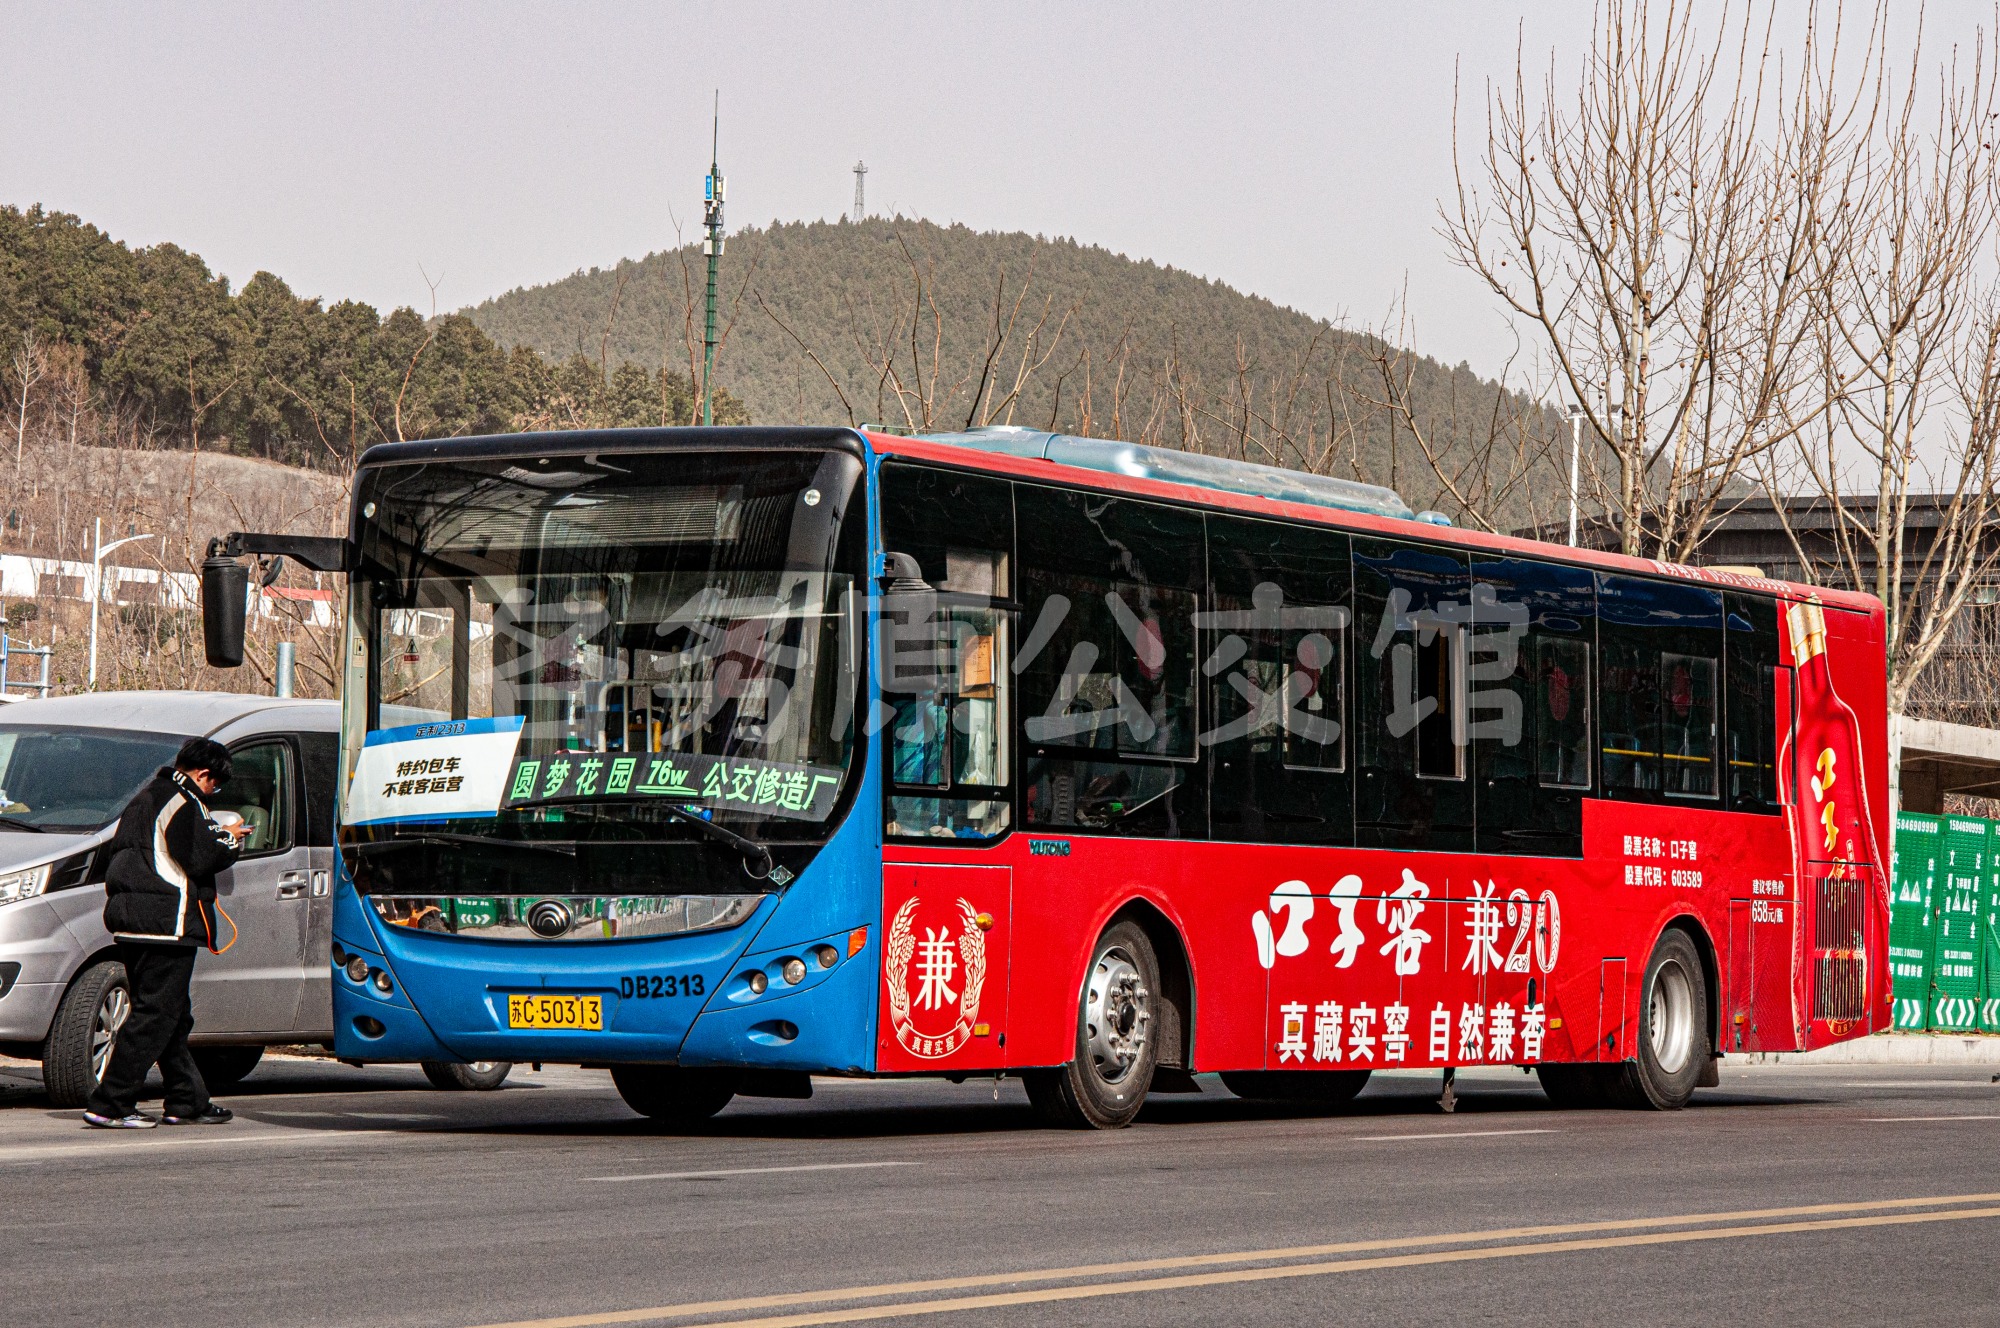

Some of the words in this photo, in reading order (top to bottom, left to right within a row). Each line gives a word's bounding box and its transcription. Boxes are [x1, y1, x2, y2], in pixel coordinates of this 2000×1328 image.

[415, 722, 466, 738] 定制2313
[396, 757, 461, 778] 特约包车
[382, 776, 464, 798] 不载客运营
[510, 758, 637, 800] 圆梦花园
[702, 762, 838, 811] 公交修造厂
[1896, 818, 1938, 834] 5846909999
[1949, 819, 1985, 835] 15846909999
[1028, 839, 1071, 857] YUTONG
[1752, 879, 1785, 896] 建议零售价
[1251, 867, 1432, 976] 口子窖
[1751, 900, 1784, 925] 658元/瓶
[913, 925, 958, 1011] 兼
[620, 974, 705, 1000] DB2313
[1278, 1000, 1411, 1063] 真藏实窖
[1428, 1001, 1546, 1062] 自然兼香
